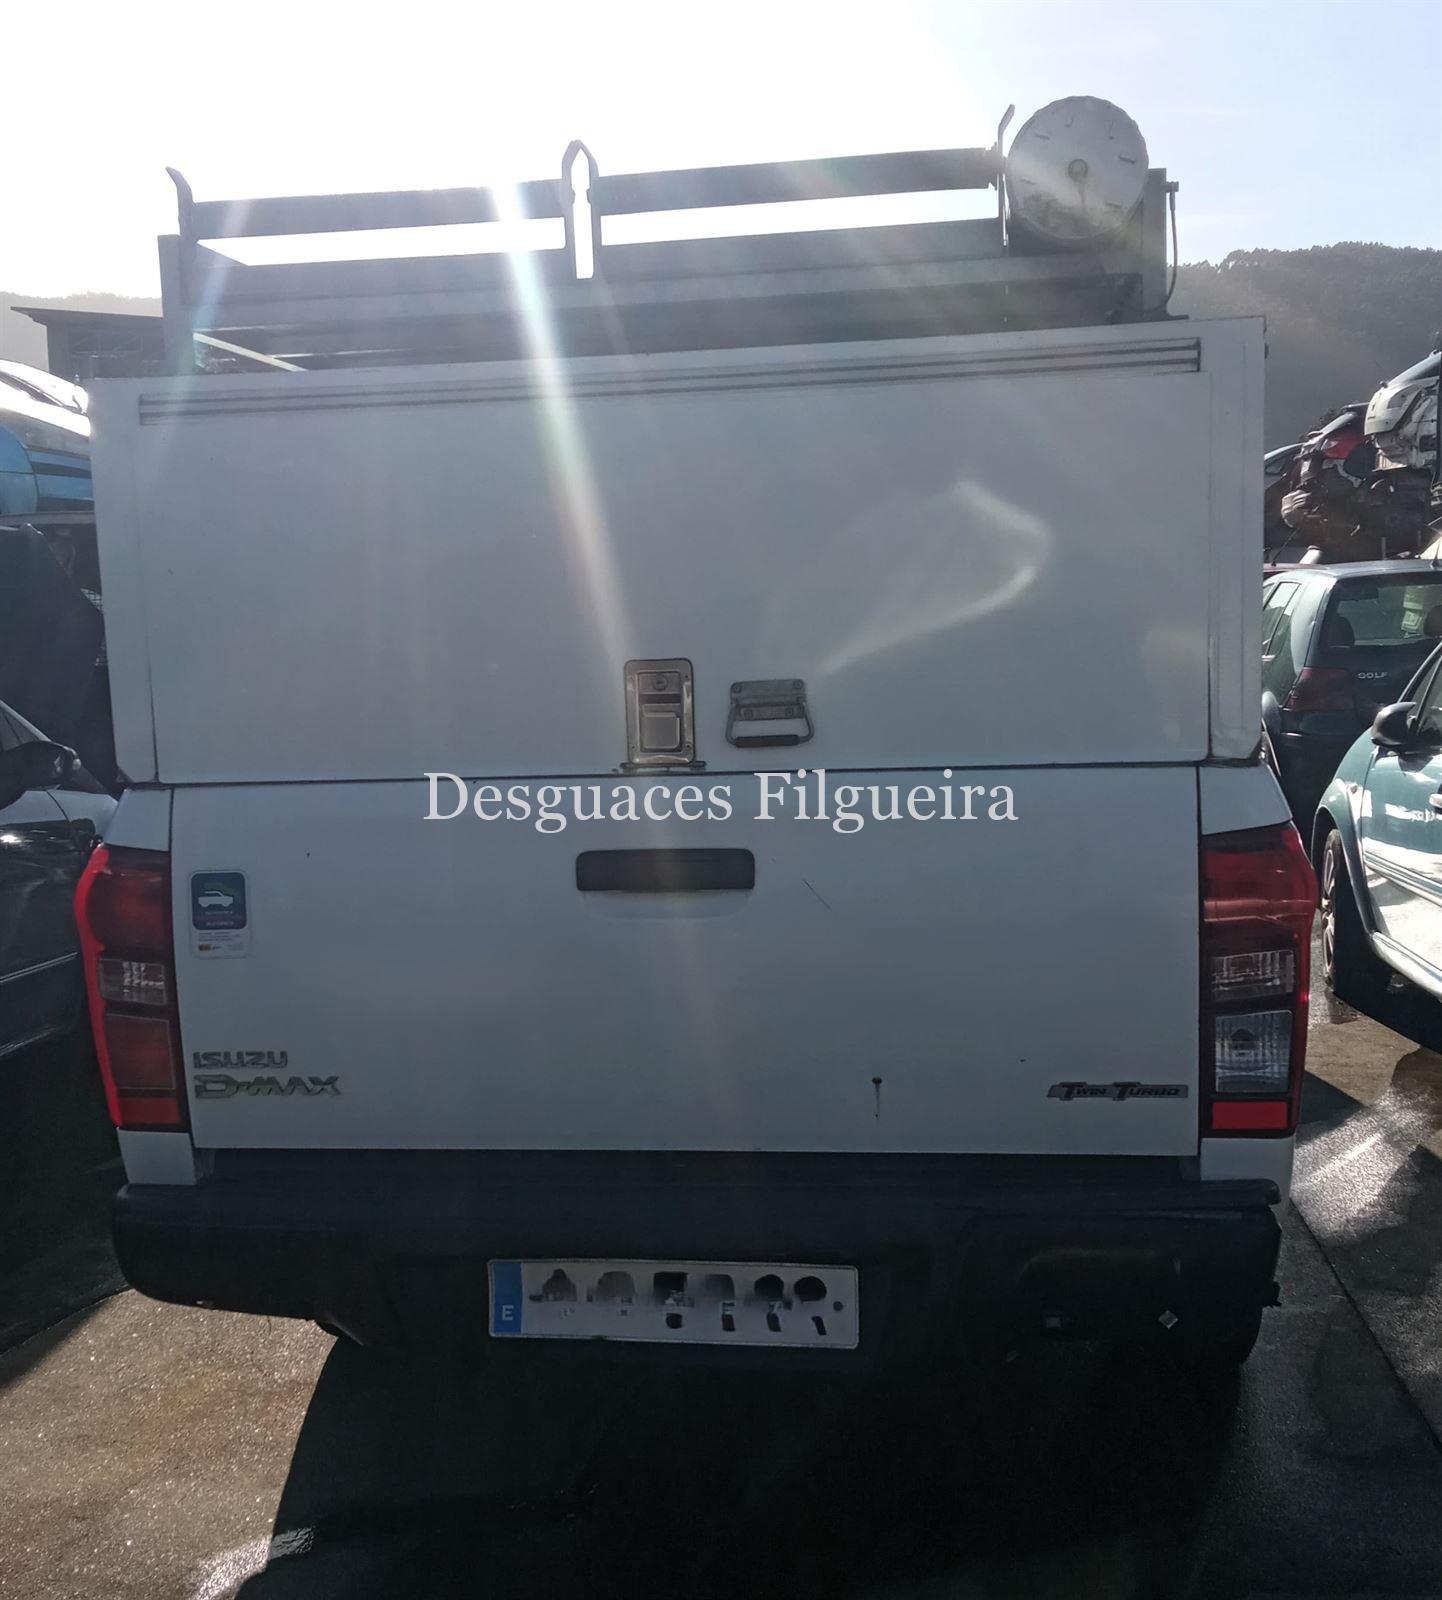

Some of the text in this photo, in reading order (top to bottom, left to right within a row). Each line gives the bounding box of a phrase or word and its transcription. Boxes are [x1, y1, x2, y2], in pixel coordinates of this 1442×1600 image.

[1357, 672, 1388, 680] GOLF
[193, 1050, 289, 1069] ISUZU
[193, 1073, 342, 1099] D-MAX
[501, 1304, 514, 1320] E
